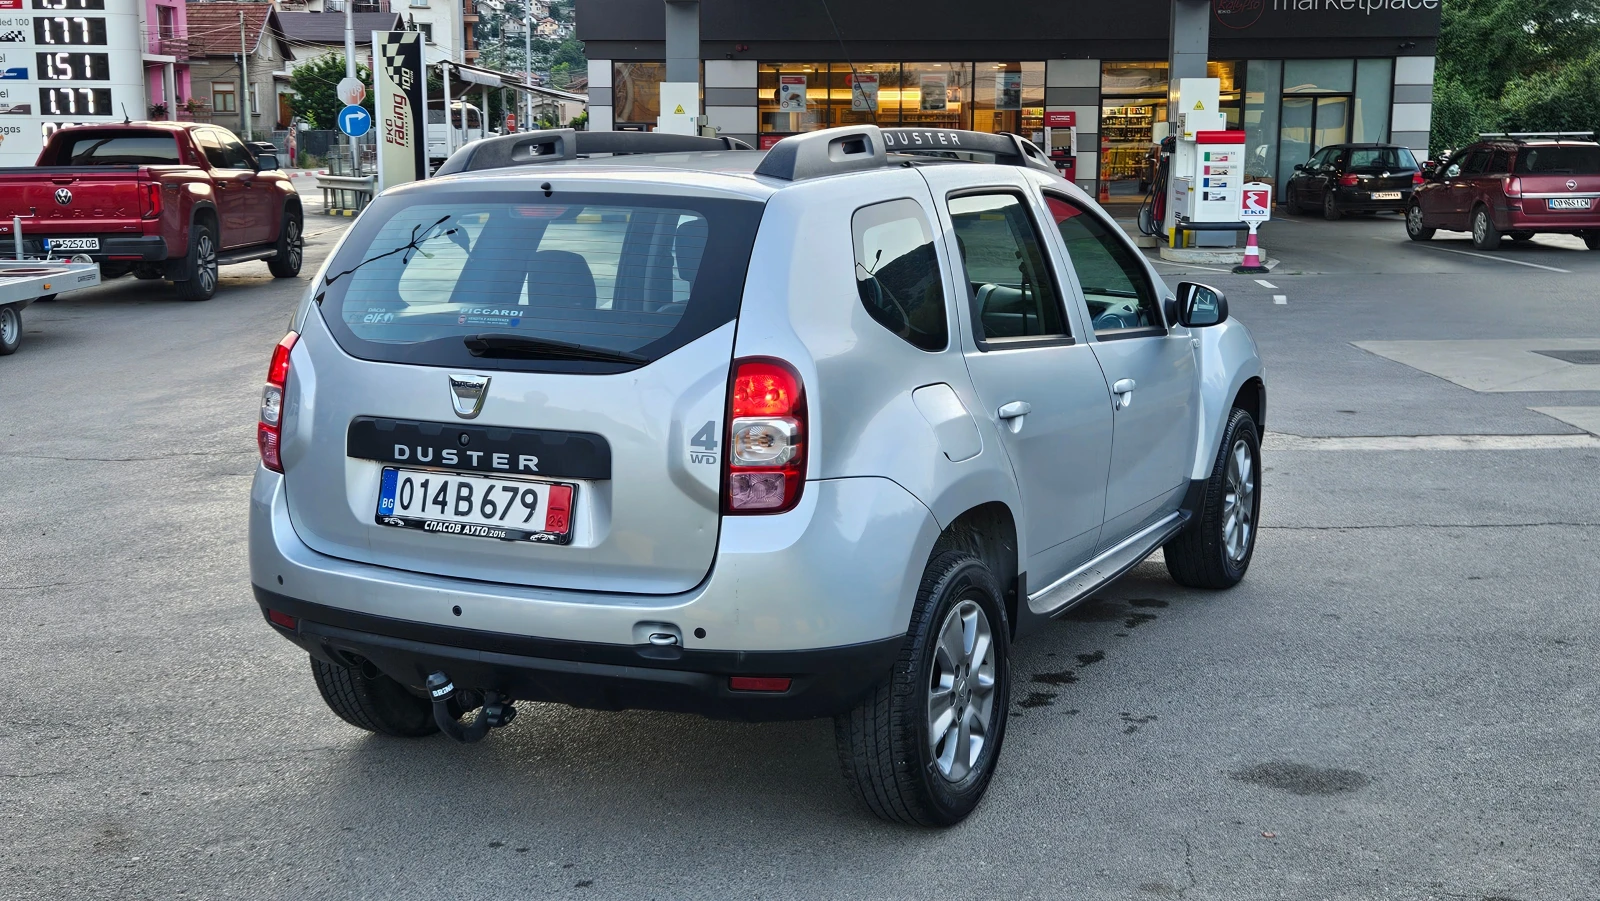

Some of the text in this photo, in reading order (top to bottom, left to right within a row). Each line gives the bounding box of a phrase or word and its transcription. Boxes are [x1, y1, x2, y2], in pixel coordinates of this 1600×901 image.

[0, 18, 30, 26] ed 100
[43, 17, 88, 44] 1.77
[47, 52, 92, 79] 1.51
[401, 67, 411, 91] 100
[50, 88, 94, 114] 1.77
[392, 93, 407, 147] racing
[385, 118, 394, 144] EKO
[883, 132, 961, 146] DUSTER
[63, 239, 84, 248] 5252
[85, 239, 97, 248] OB
[363, 312, 385, 323] elf
[460, 307, 524, 317] PICCARDI
[690, 420, 718, 451] 4
[394, 444, 539, 472] DUSTER
[690, 453, 717, 465] WD
[382, 497, 394, 509] BG
[424, 520, 507, 538] СПАСОВ АУТО 2016
[548, 515, 564, 528] 26
